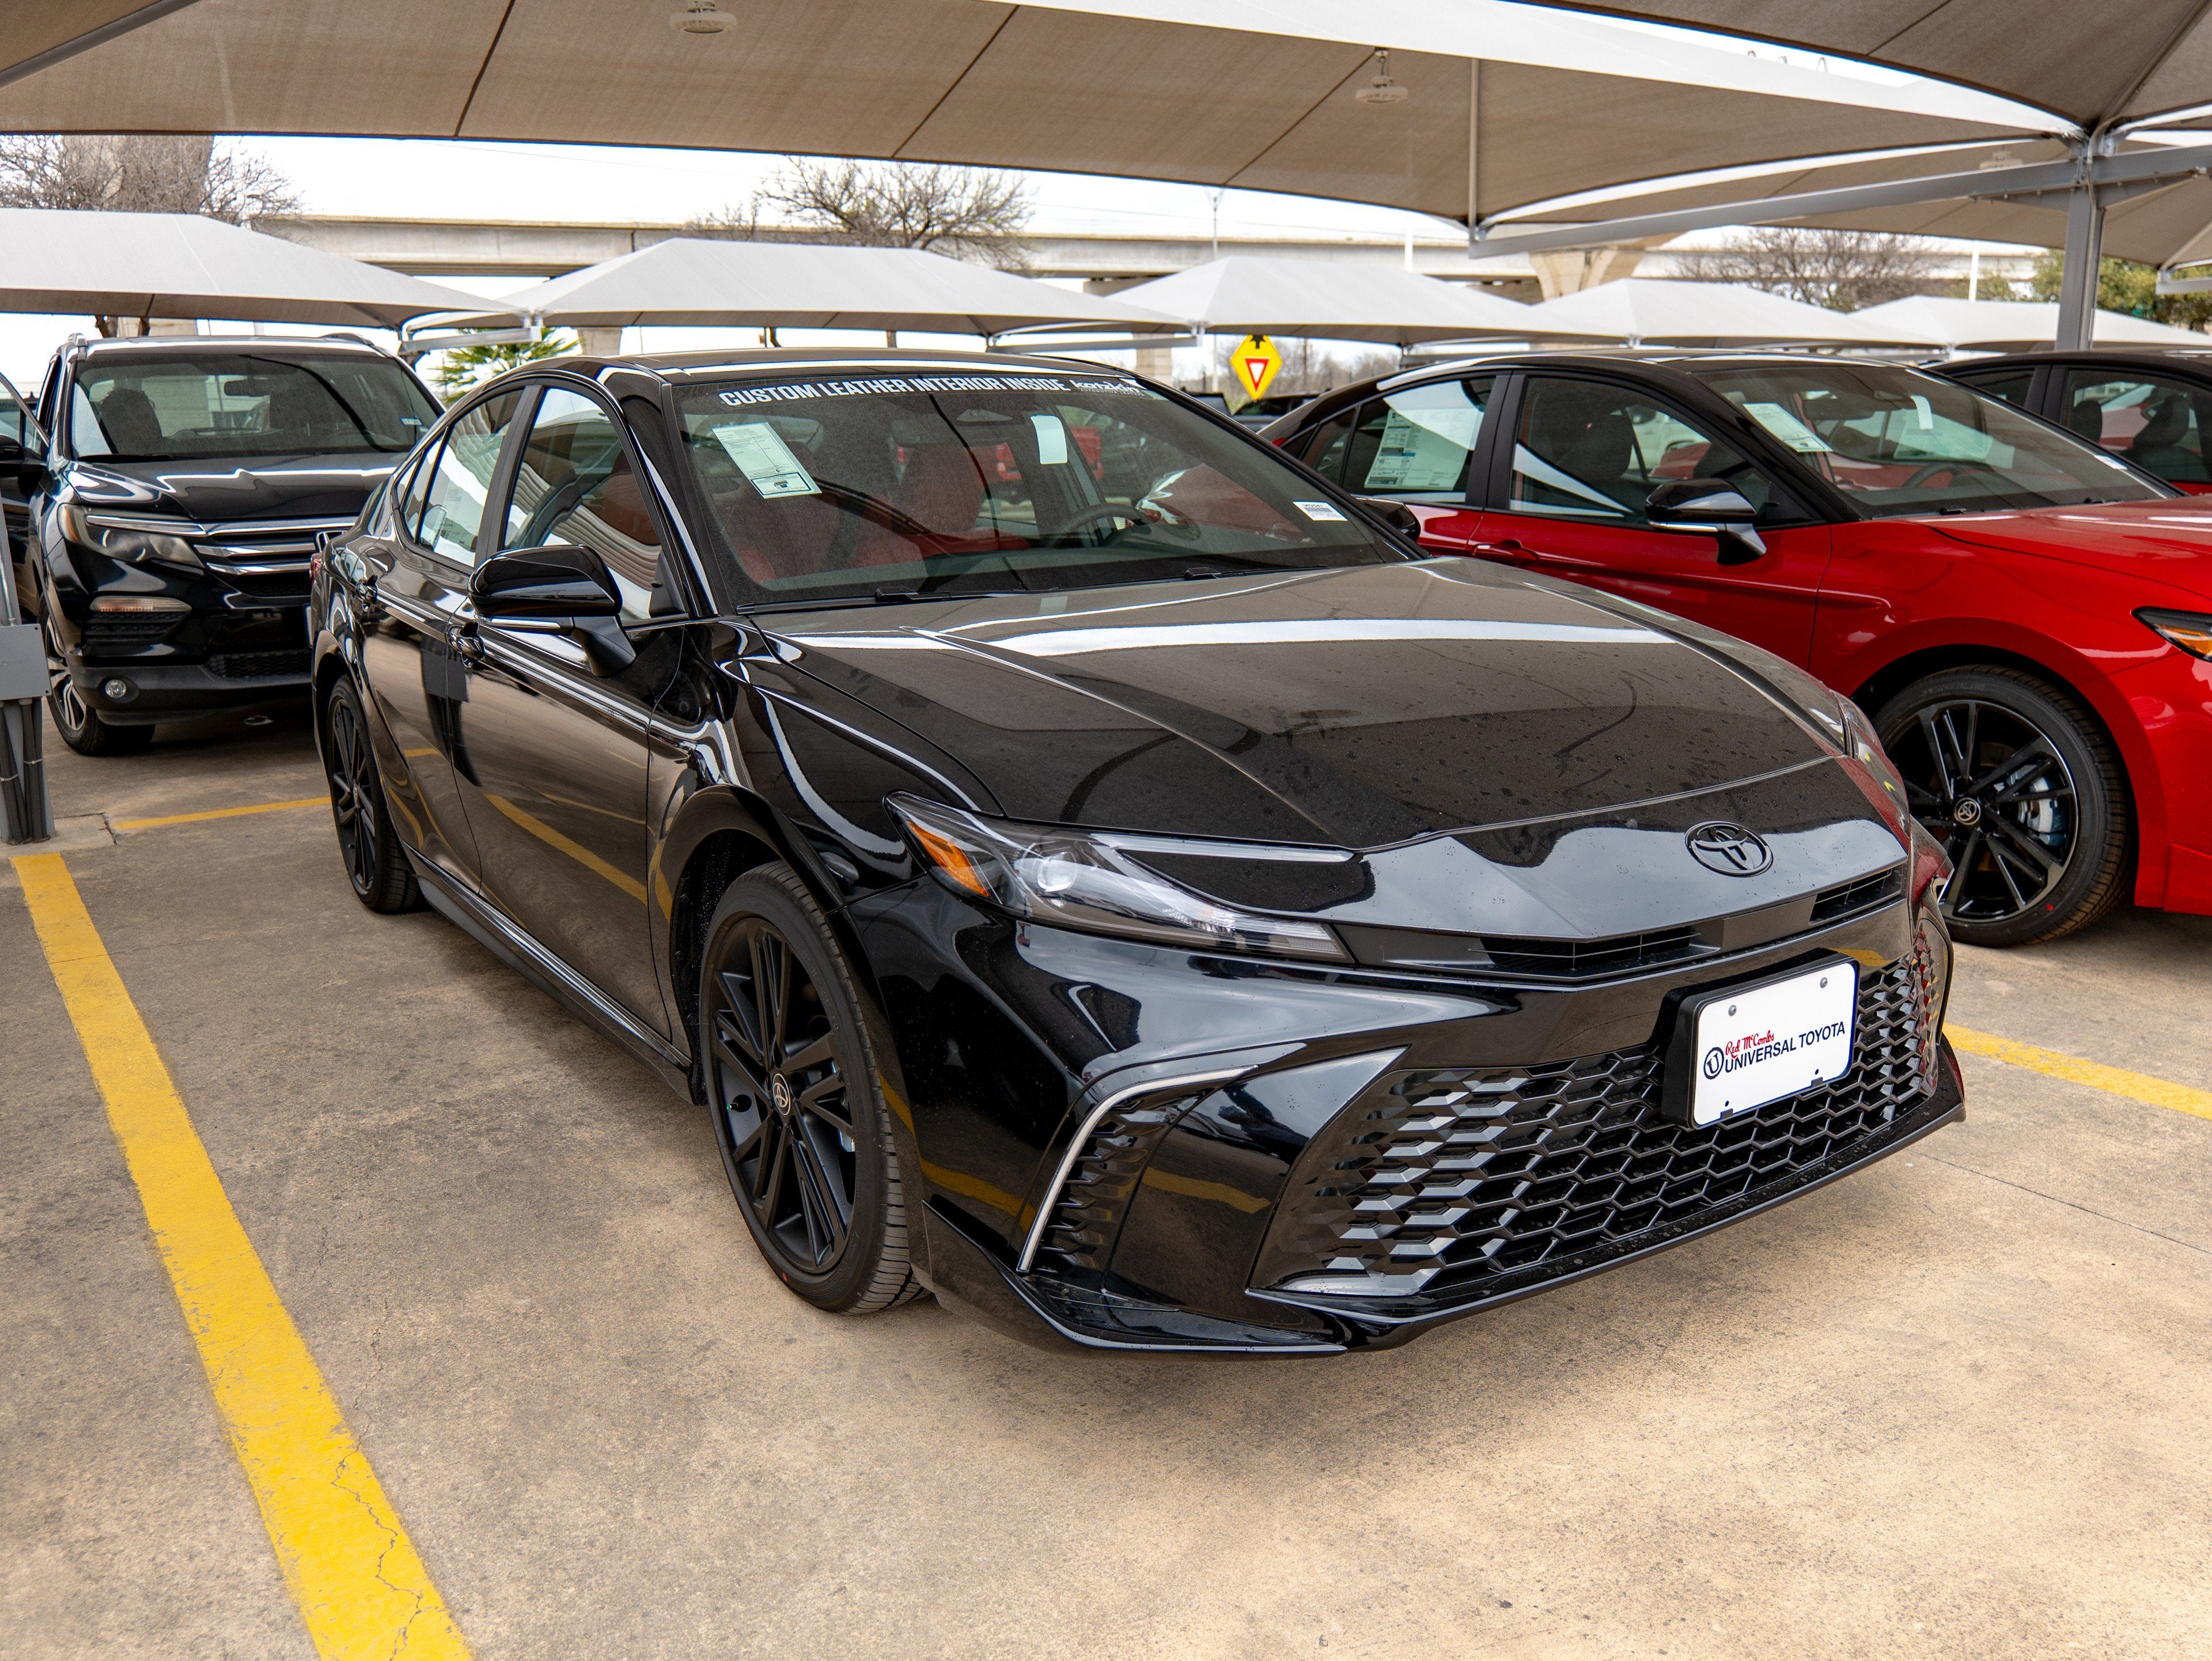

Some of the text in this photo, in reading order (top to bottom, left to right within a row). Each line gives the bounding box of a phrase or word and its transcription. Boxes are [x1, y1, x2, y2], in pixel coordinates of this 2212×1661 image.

[718, 377, 1071, 406] CUSTOM LEATHER INTERIOR INSIDE
[1725, 1030, 1774, 1058] Red McCombs
[1725, 1021, 1845, 1073] UNIVERSAL TOYOTA
